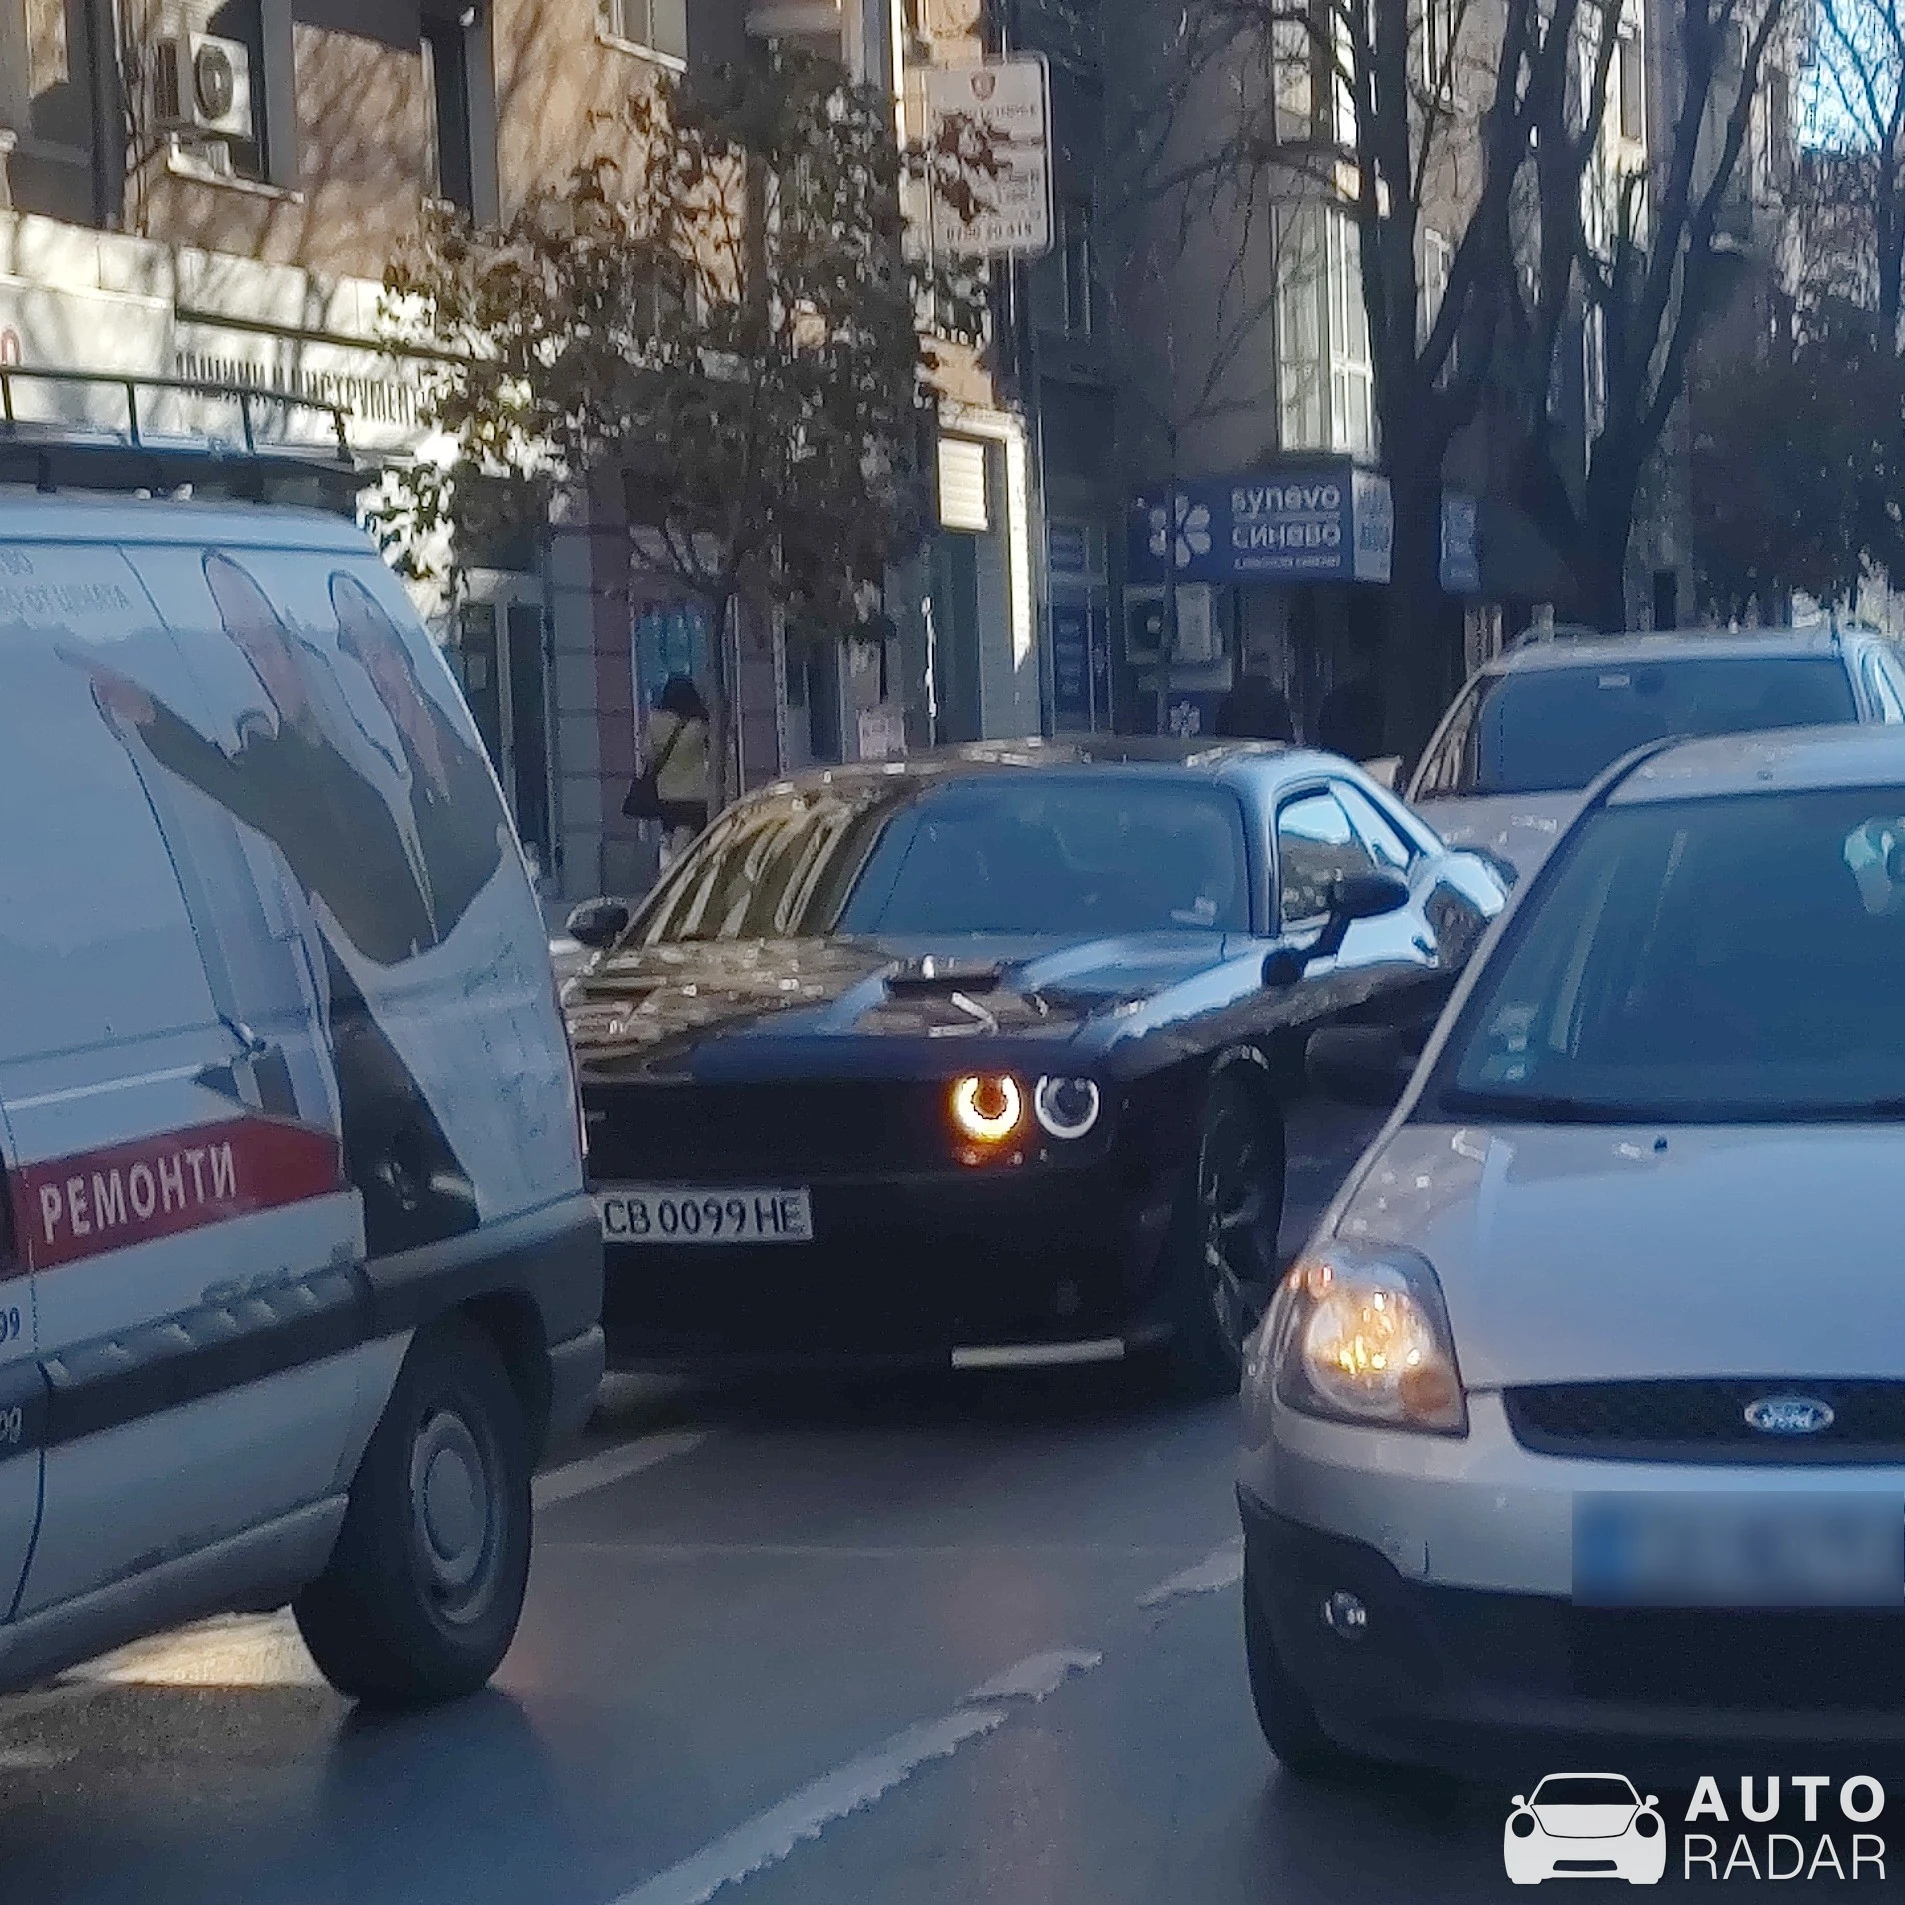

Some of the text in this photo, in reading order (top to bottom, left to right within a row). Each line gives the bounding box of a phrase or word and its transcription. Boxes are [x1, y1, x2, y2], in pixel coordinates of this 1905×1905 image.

[1232, 485, 1341, 519] synevo
[40, 1141, 236, 1244] РЕМОНТИ
[658, 1198, 746, 1235] 0099
